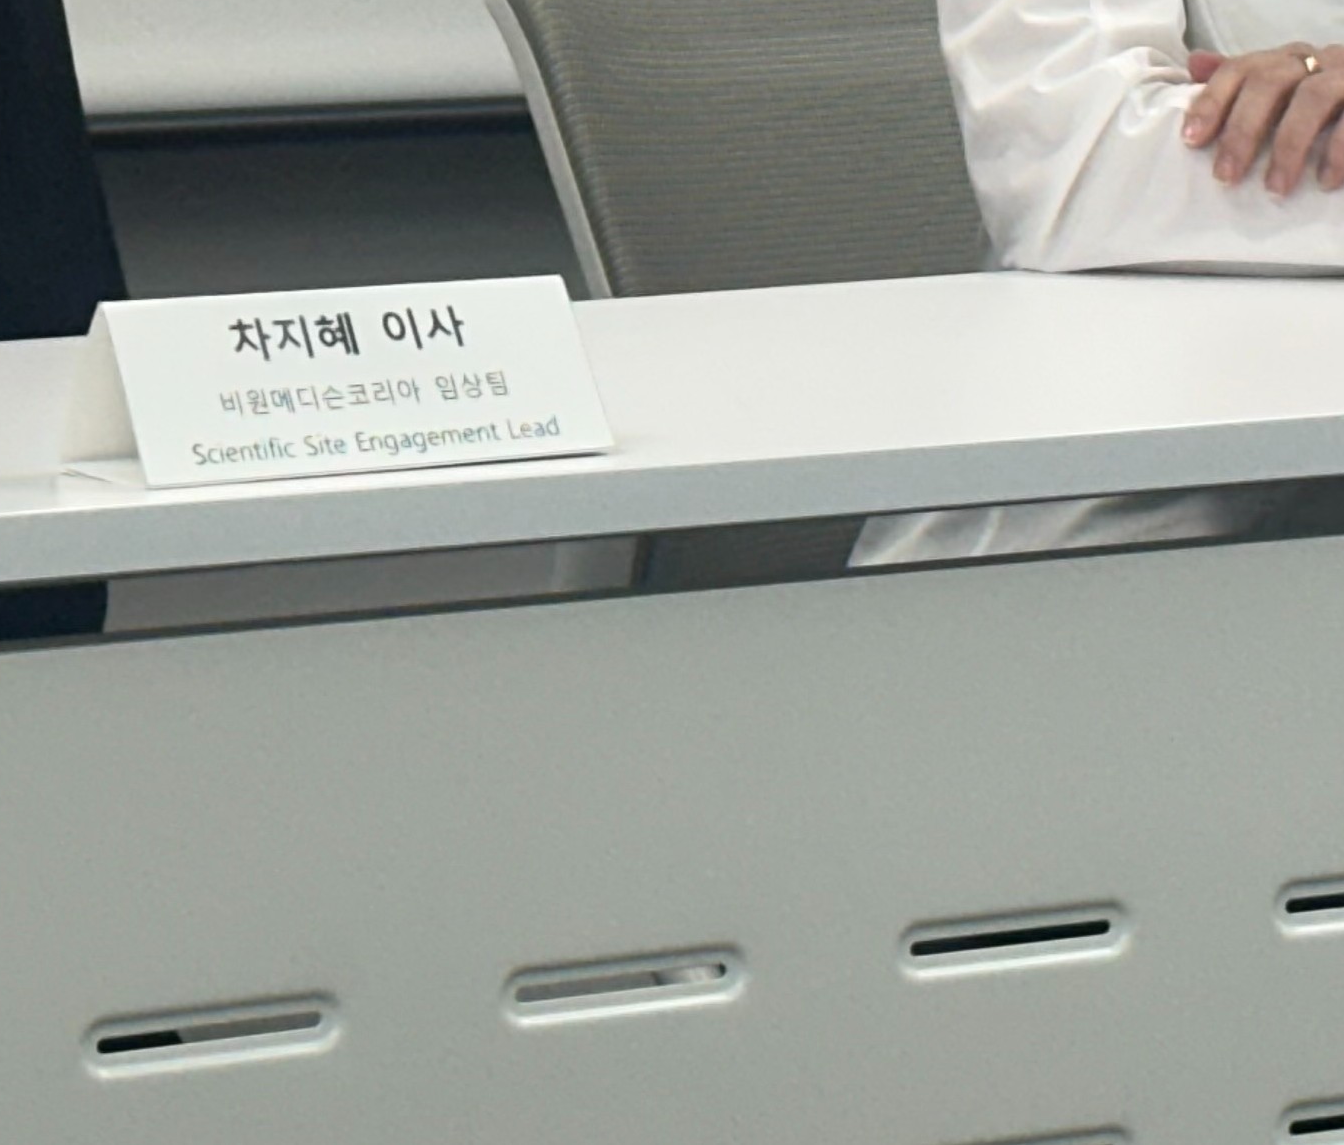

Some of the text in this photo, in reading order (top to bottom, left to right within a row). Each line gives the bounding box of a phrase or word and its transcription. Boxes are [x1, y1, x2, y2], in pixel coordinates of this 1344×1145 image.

[229, 305, 465, 360] 차지혜 이사
[219, 370, 508, 416] 비원메디슨코리아 임상팀
[192, 415, 561, 466] Scientific Site Engagement Lead
